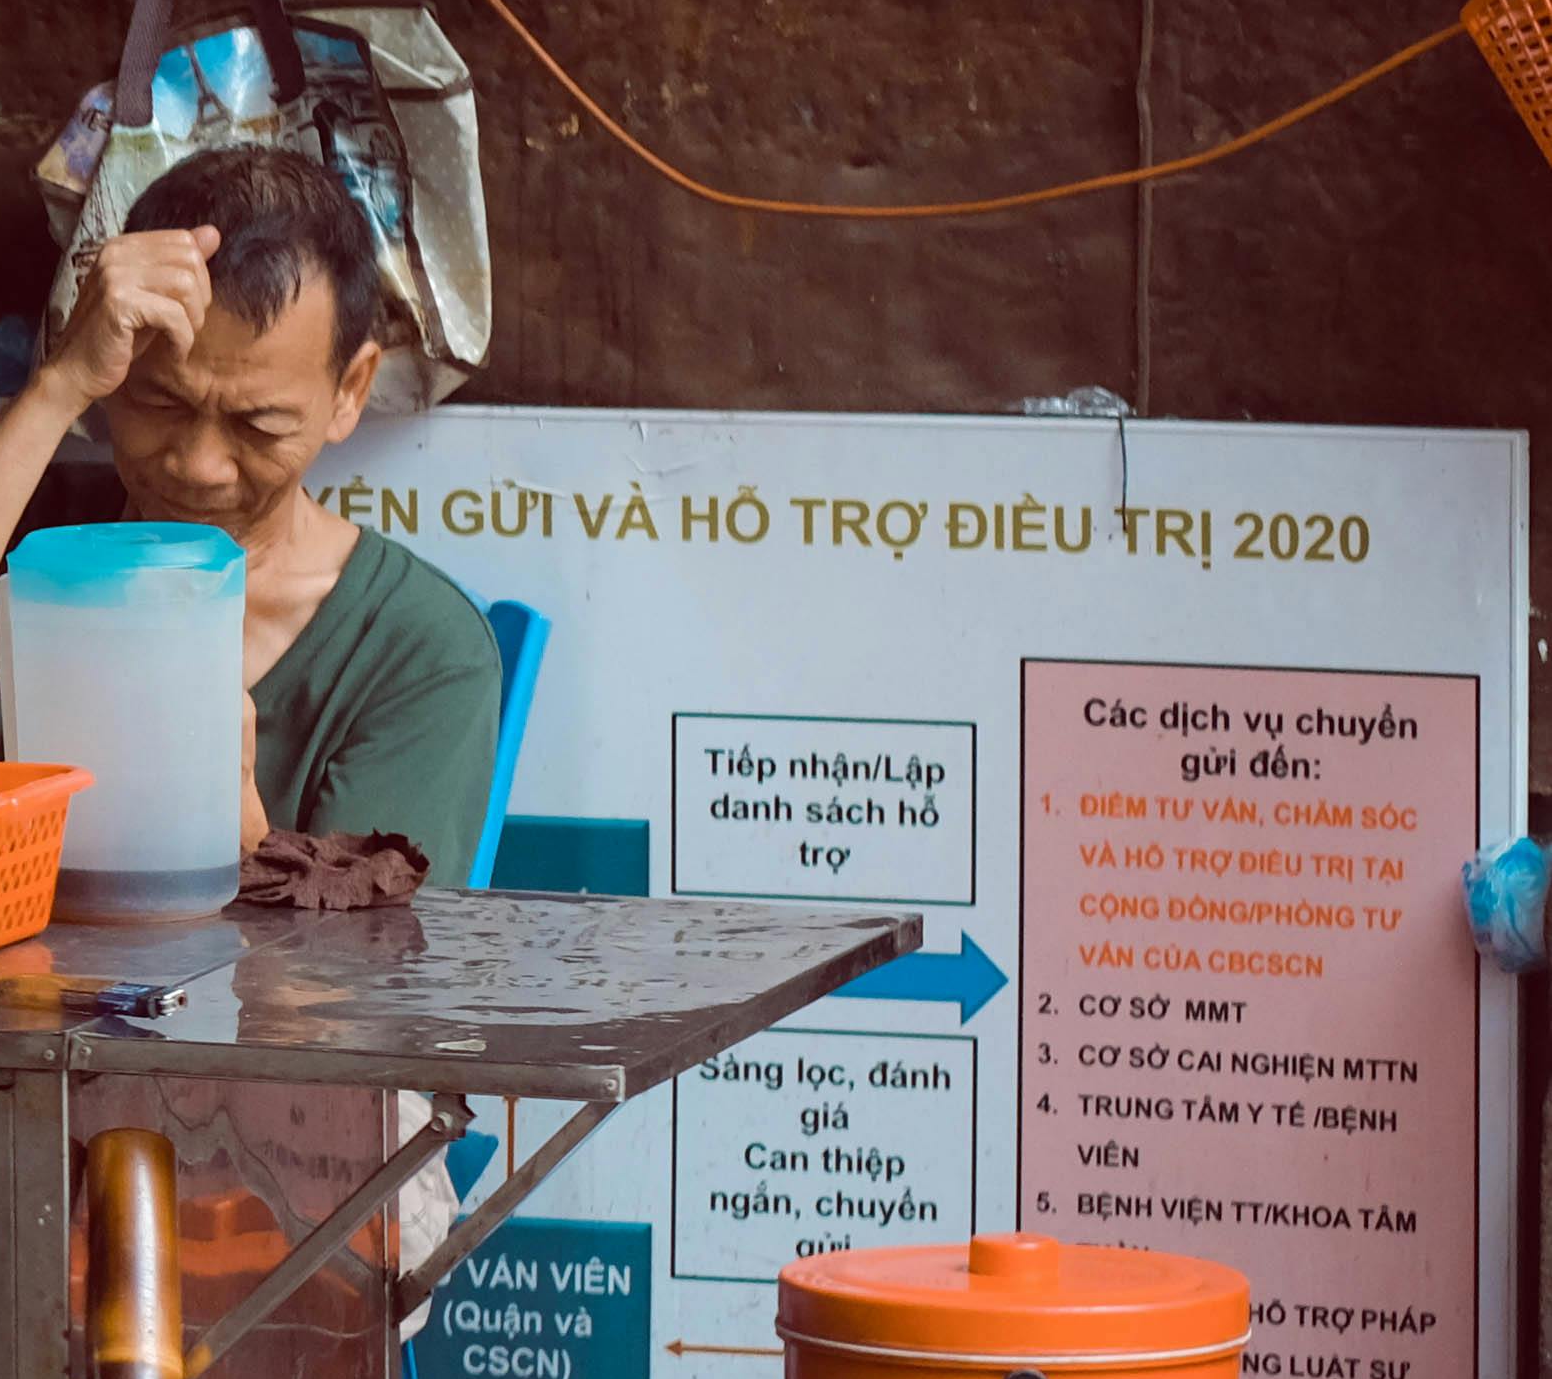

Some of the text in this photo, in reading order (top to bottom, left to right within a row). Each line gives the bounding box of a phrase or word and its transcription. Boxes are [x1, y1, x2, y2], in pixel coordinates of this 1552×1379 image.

[443, 479, 1371, 569] GỬI VÀ HỖ TRỢ ĐIỀU TRỊ 2020
[1083, 698, 1419, 745] Các dịch vụ chuyển
[704, 742, 947, 790] Tiếp nhận/Lập
[1180, 744, 1322, 782] gửi đến:
[710, 792, 941, 828] danh sách hỗ
[1040, 792, 1418, 831] 1. TƯ SÓC
[799, 840, 852, 875] trợ
[1079, 839, 1234, 879] VÀ TRỢ
[1079, 891, 1404, 931] CỘNG TƯ
[1208, 950, 1325, 978] CBCSCN
[1037, 992, 1247, 1024] 2. CƠ SỞ MMT
[797, 1057, 856, 1093] lọc,
[868, 1058, 952, 1091] đánh
[1038, 1043, 1418, 1084] 3. CƠ SỞ CAI NGHIỆN MTTN
[799, 1100, 851, 1136] giá
[1036, 1093, 1058, 1115] 4.
[1078, 1093, 1174, 1121] TRUNG
[1247, 1102, 1264, 1124] Y
[1313, 1106, 1397, 1136] /BỆNH
[744, 1142, 906, 1182] Can thiệp
[709, 1181, 939, 1228] ngắn, chuyển
[1035, 1191, 1350, 1230] 5. BỆNH VIỆN TT/KHOA
[467, 1252, 632, 1296] VẤN VIÊN
[442, 1299, 594, 1340] (Quận và
[1293, 1304, 1437, 1335] TRỢ PHÁP
